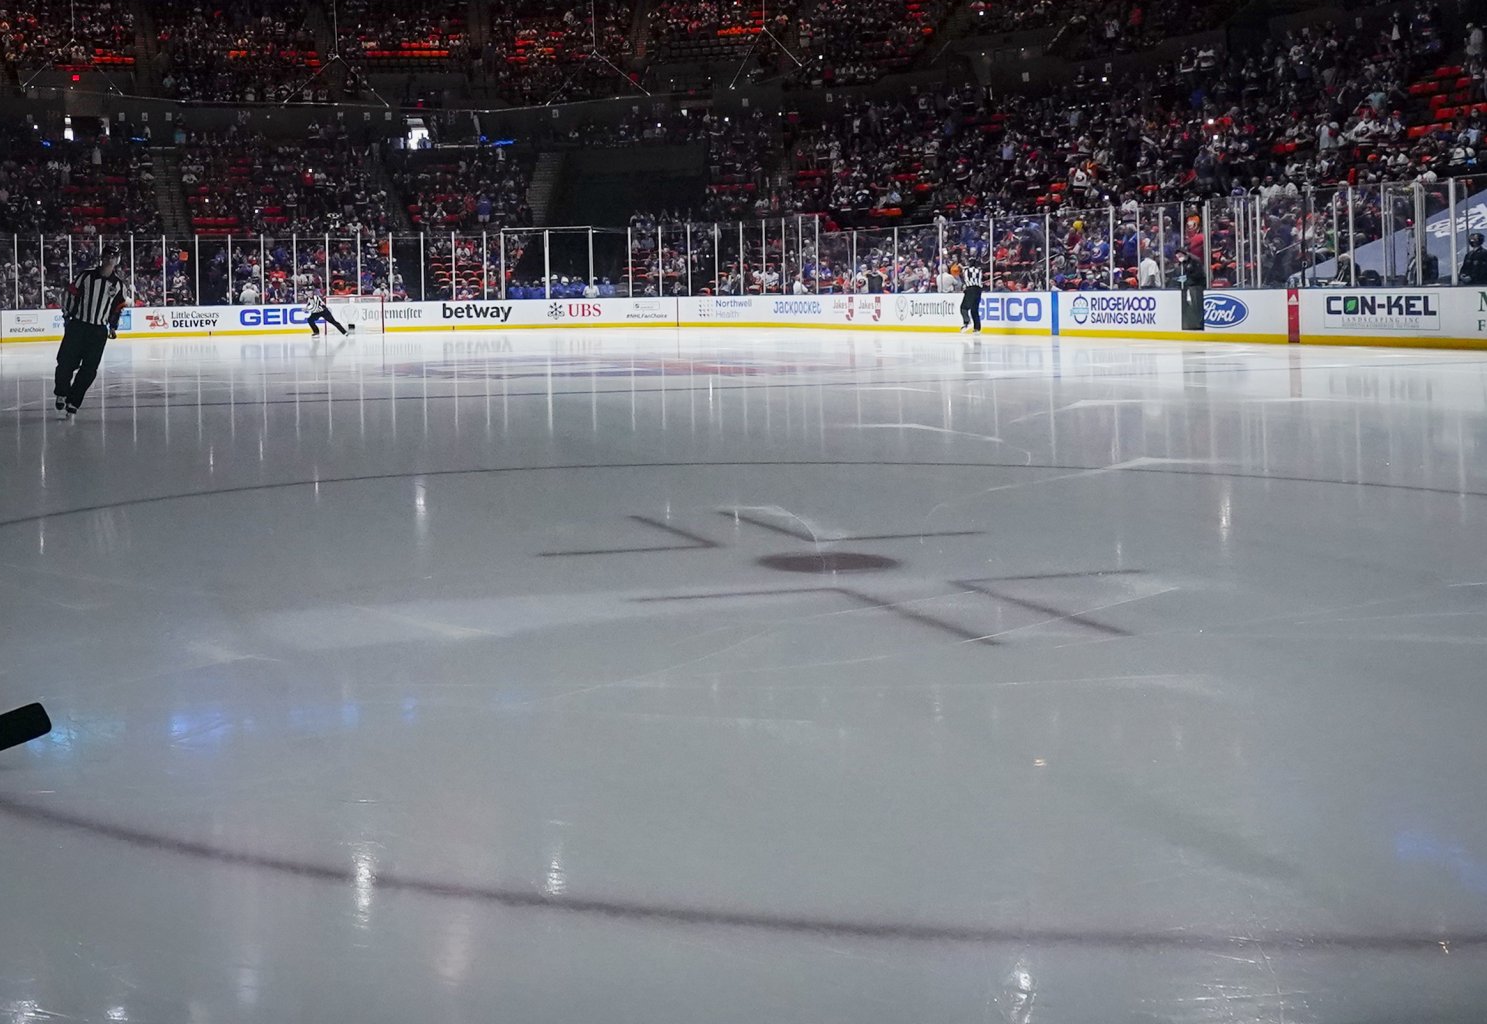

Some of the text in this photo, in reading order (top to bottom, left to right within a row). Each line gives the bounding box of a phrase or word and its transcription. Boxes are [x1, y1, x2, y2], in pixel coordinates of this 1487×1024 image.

[568, 303, 602, 317] UBS
[715, 299, 752, 309] Northwell
[1090, 296, 1157, 311] RIDGEWOOD
[1203, 299, 1237, 322] Ford
[1326, 296, 1437, 316] CON-KEL
[171, 311, 220, 319] Little Caesars
[239, 308, 324, 327] GEIC
[442, 303, 512, 322] betway
[715, 309, 740, 319] Health
[1090, 312, 1157, 325] SAVINGS BANK
[172, 319, 218, 328] DELIVERY
